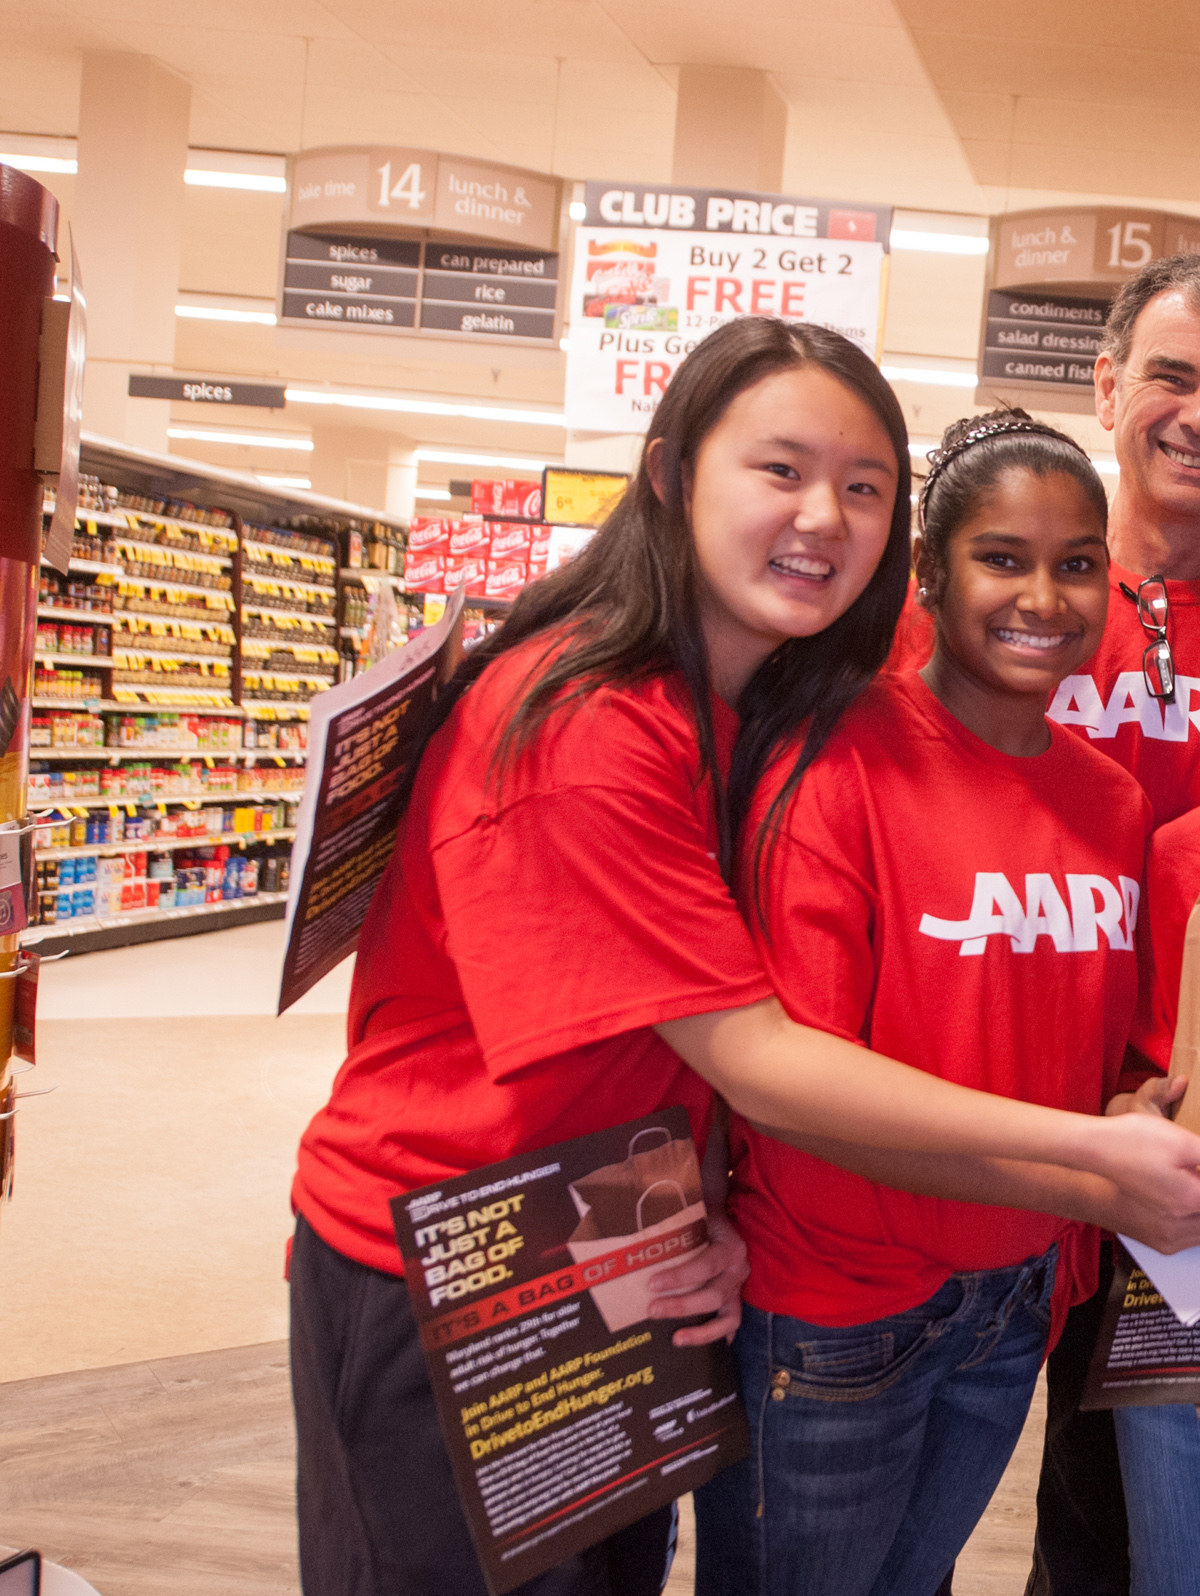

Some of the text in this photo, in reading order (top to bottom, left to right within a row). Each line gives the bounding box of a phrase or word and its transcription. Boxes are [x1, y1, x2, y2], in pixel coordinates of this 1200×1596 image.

[376, 160, 425, 209] 14
[449, 173, 532, 208] lunch &
[455, 196, 526, 225] dinner
[599, 189, 820, 238] CLUB PRICE
[328, 243, 379, 262] spices
[1011, 226, 1077, 249] lunch &
[1107, 221, 1153, 269] 15
[440, 252, 545, 276] can prepared
[689, 245, 854, 275] Buy 2 Get 2
[1014, 249, 1071, 268] dinner
[330, 273, 373, 293] sugar
[474, 284, 506, 302] rice
[686, 275, 807, 317] FREE
[305, 301, 394, 322] cake mixes
[461, 313, 515, 332] gelatin
[1009, 302, 1103, 321] condiments
[600, 332, 699, 355] Plus Ge
[998, 330, 1102, 354] salad dressin
[1004, 361, 1066, 377] canned
[183, 380, 232, 402] spices
[919, 872, 1141, 957] AARP
[414, 1193, 526, 1248] IT'S NOT
[420, 1219, 518, 1267] JUST A
[424, 1235, 526, 1288] BAG OF
[428, 1263, 514, 1308] FOOD.
[491, 1300, 509, 1317] A
[519, 1274, 575, 1309] BAG
[583, 1258, 617, 1283] OF
[488, 1383, 523, 1409] AARP
[523, 1370, 549, 1394] and
[549, 1356, 585, 1382] AARP
[583, 1331, 652, 1369] Foundation
[470, 1365, 655, 1460] DrivetoEndHunger.org
[480, 1406, 515, 1432] Drive
[515, 1399, 531, 1416] to
[530, 1388, 555, 1411] End
